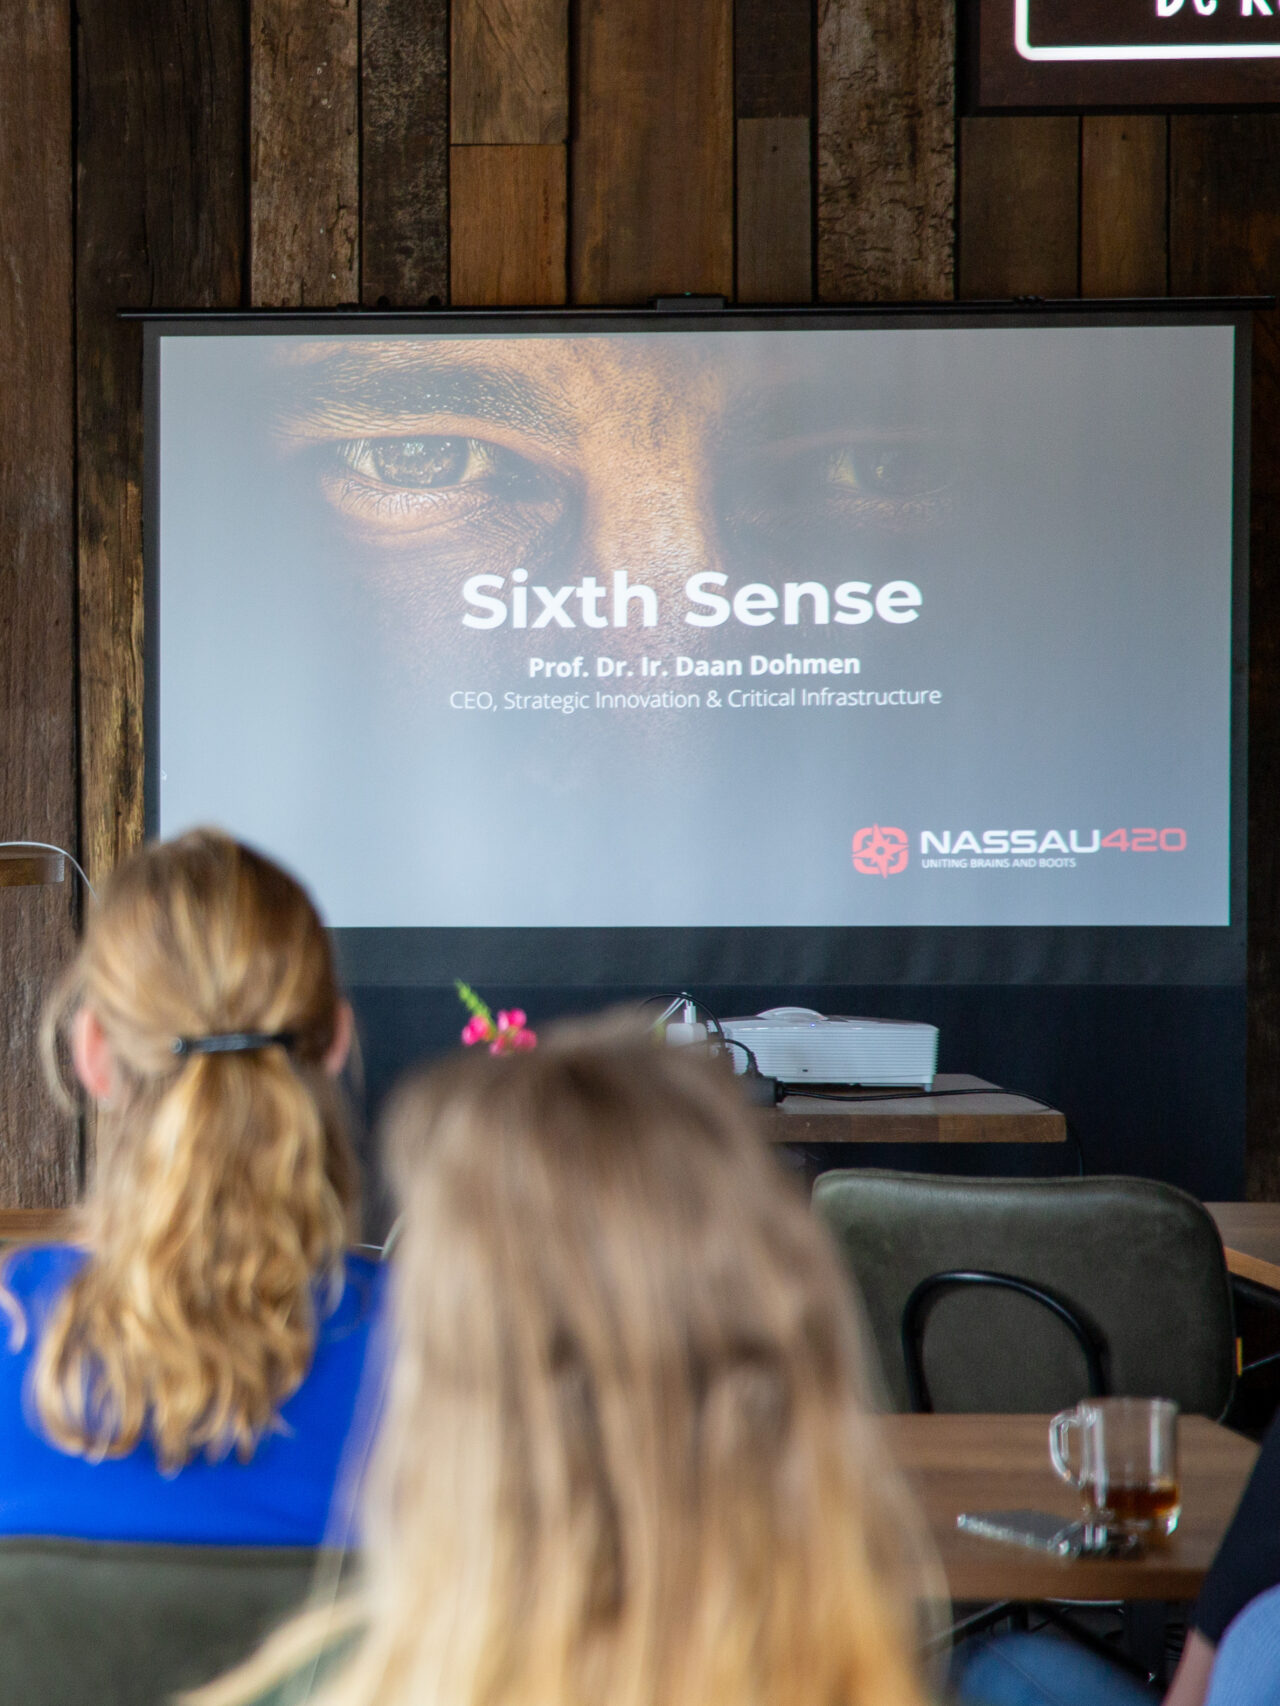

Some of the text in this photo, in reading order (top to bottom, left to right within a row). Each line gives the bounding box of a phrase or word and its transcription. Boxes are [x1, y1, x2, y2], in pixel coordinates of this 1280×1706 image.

[461, 568, 923, 629] Sixth Sense
[529, 653, 861, 678] Prof. Dr. Ir. Daan Dohmen
[449, 687, 943, 714] CEO, Strategic Innovation & Critical Infrastructure
[921, 857, 1077, 869] UNITING BRAINS AND BOOTS
